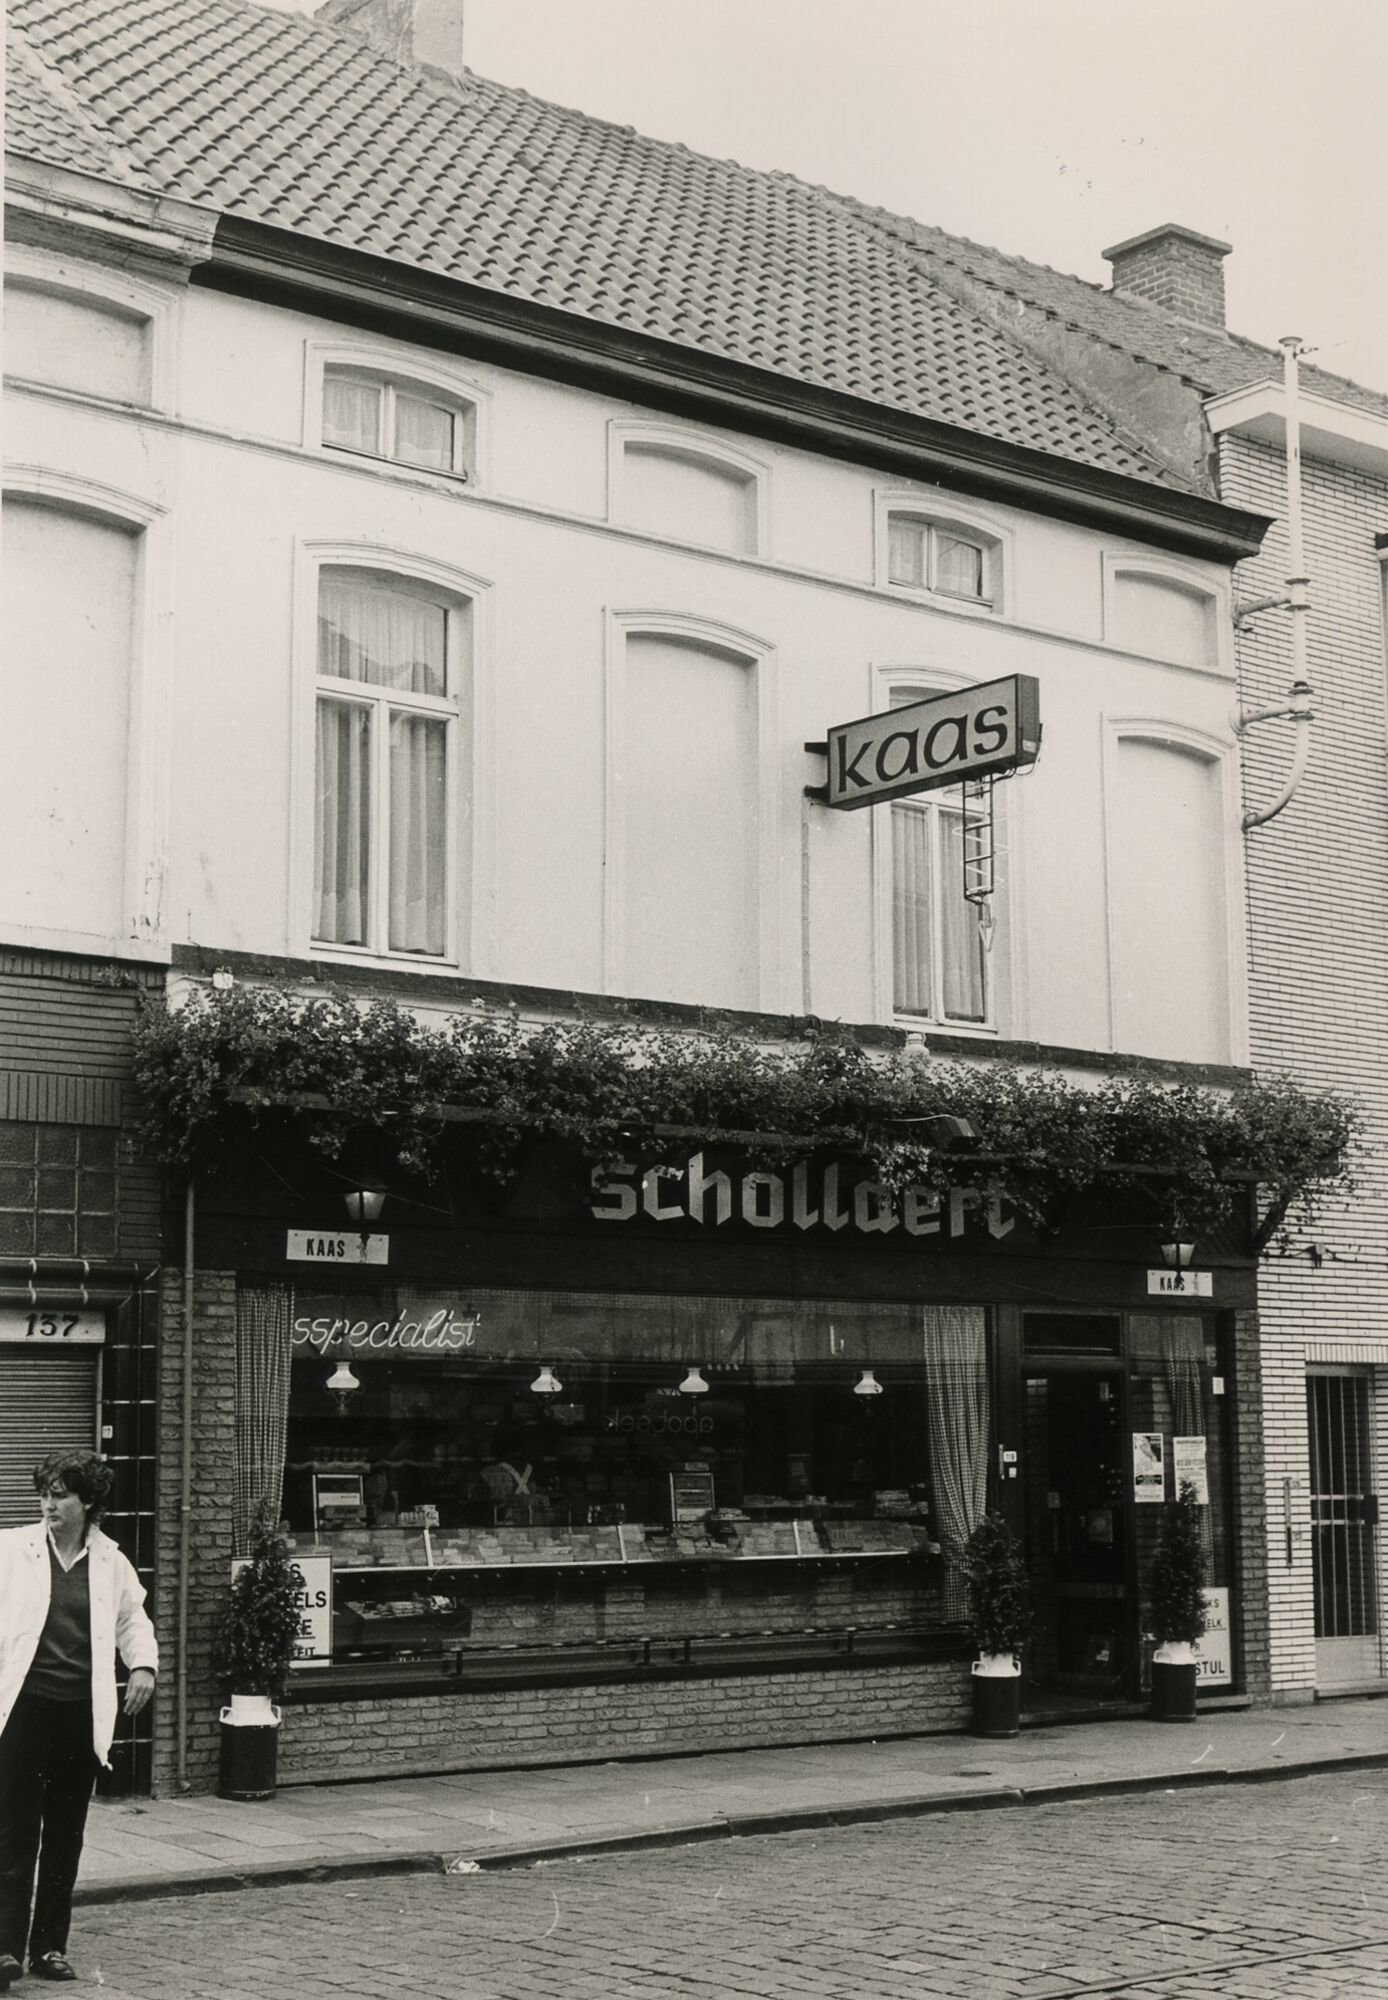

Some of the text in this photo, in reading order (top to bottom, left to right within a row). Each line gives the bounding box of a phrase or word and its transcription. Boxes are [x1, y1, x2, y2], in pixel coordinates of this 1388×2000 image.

[837, 705, 1008, 793] kaas
[306, 1238, 345, 1258] KAAS
[25, 1313, 79, 1337] 137
[289, 1591, 327, 1608] ELS
